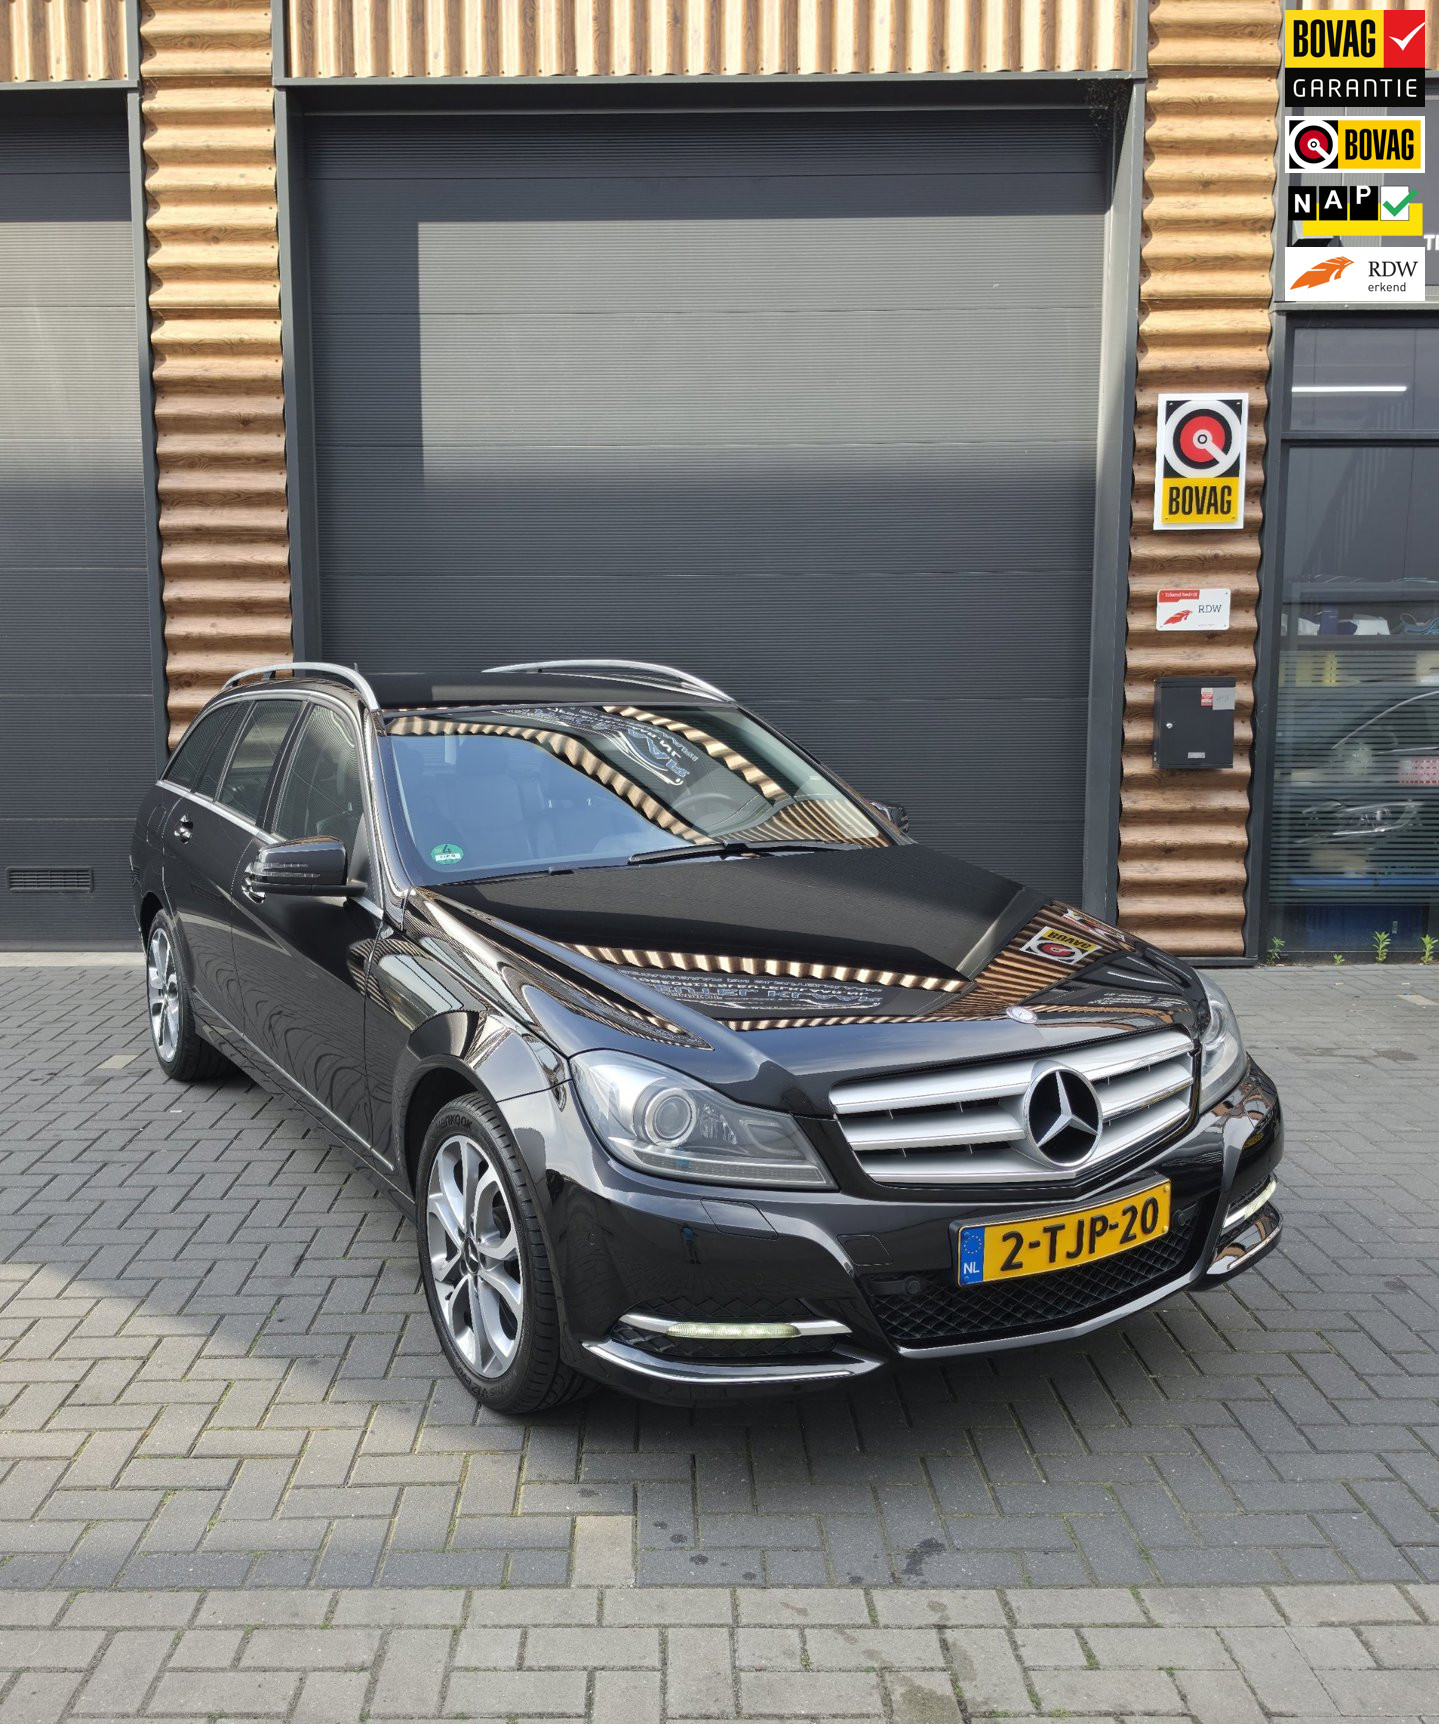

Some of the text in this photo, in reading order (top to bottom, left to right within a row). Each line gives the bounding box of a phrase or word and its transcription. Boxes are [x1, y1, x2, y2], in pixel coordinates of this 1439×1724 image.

[1168, 485, 1232, 515] BOVAG
[1198, 605, 1222, 613] RDW
[1000, 1196, 1159, 1272] 2-TJP-20
[963, 1261, 980, 1275] NL
